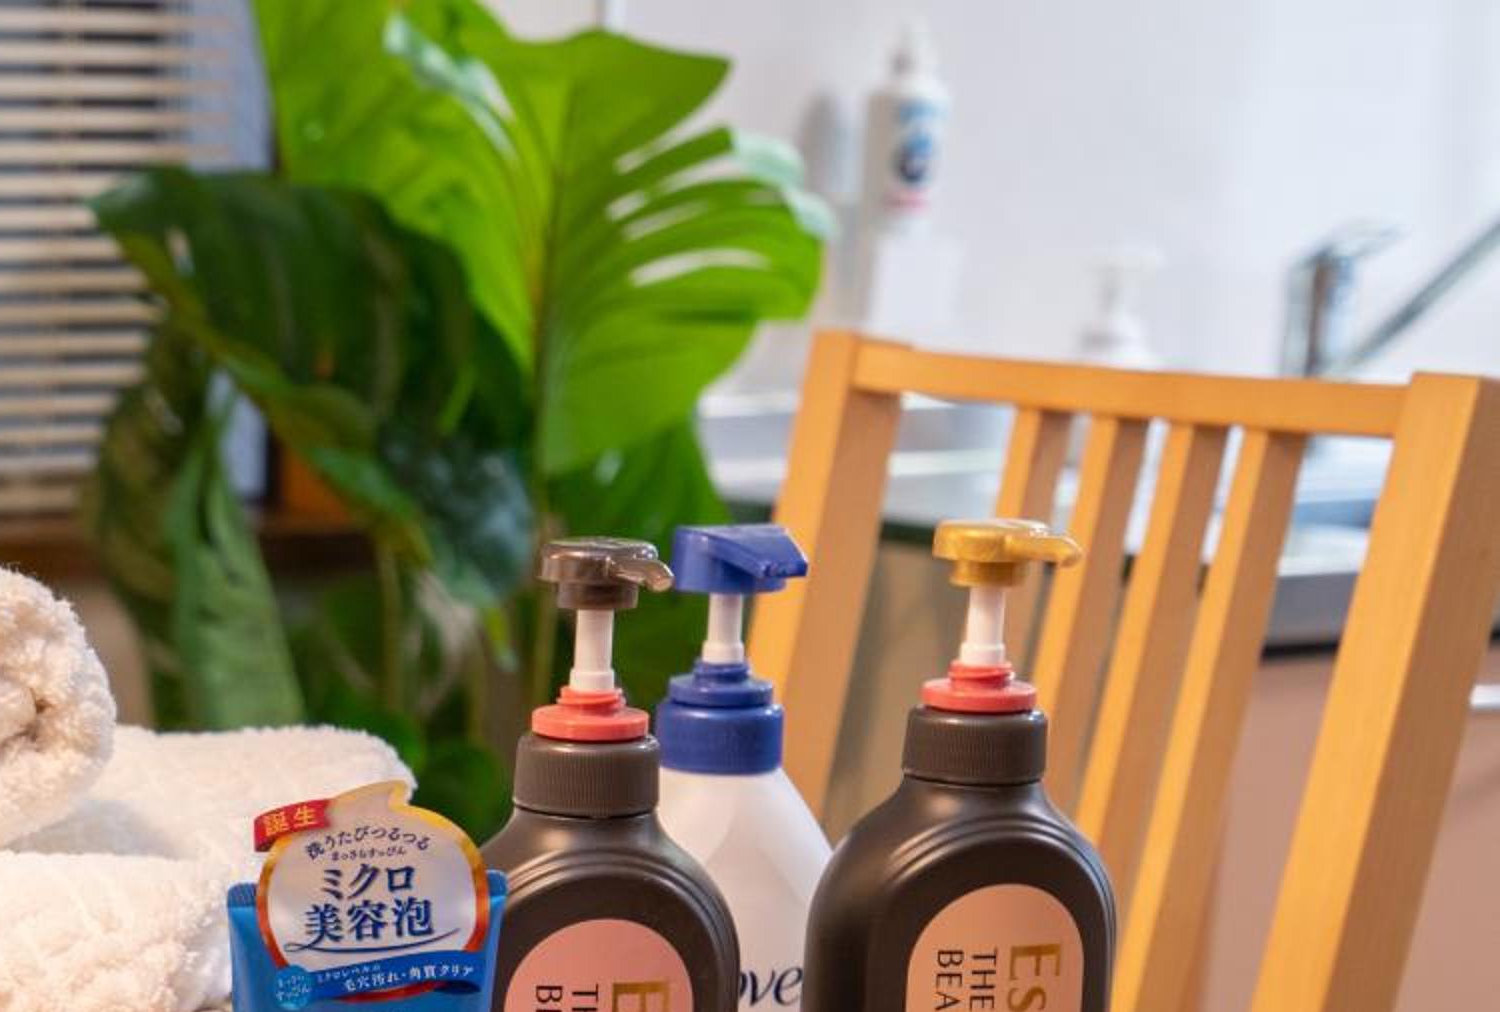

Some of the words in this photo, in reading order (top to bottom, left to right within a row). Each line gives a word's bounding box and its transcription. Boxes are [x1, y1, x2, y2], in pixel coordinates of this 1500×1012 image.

[263, 805, 317, 834] 誕生
[322, 863, 415, 900] ミクロ
[304, 896, 435, 946] 美容泡
[969, 947, 998, 1012] THE
